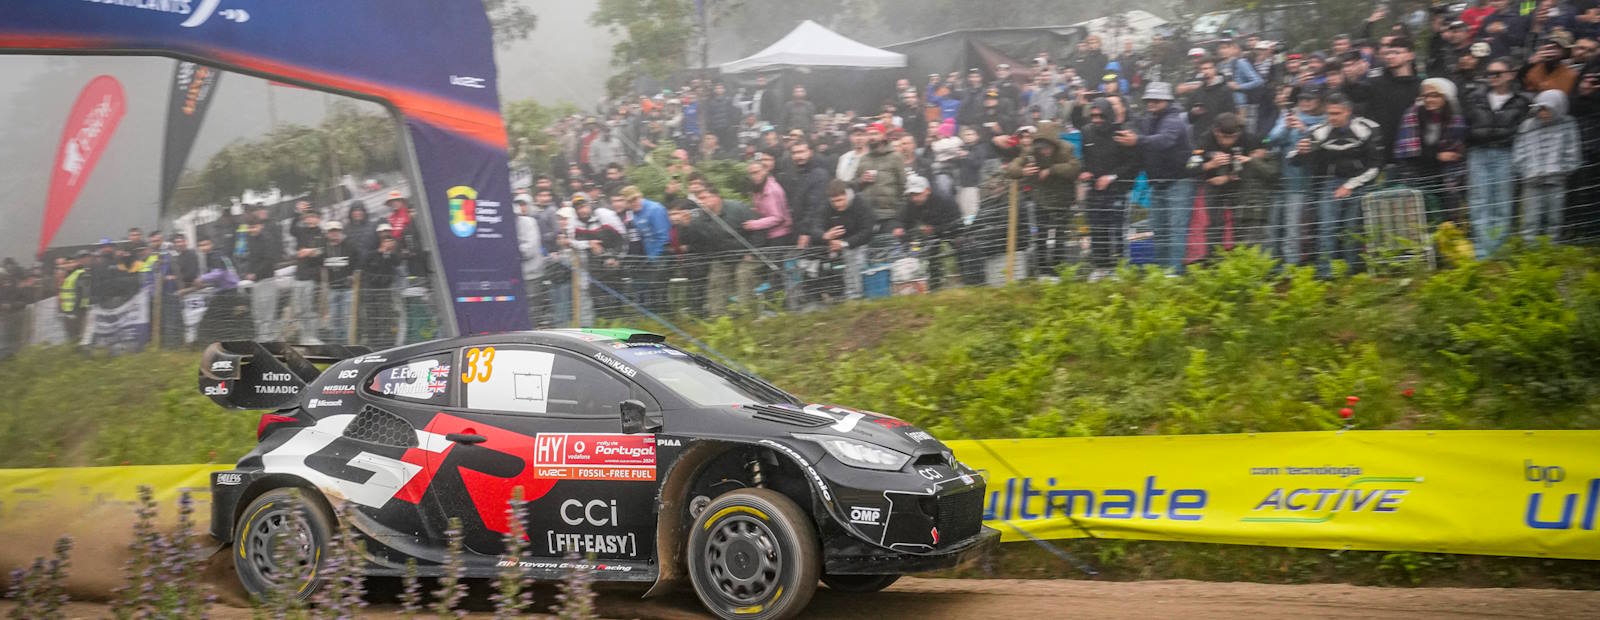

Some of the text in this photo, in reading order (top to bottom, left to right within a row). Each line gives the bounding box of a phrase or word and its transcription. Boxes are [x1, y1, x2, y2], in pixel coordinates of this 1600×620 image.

[462, 347, 496, 384] 33
[254, 385, 299, 394] TAMADIC
[538, 436, 563, 463] HY
[595, 445, 656, 458] Portugal
[567, 453, 591, 461] vodafone
[538, 468, 568, 477] WRC
[578, 469, 652, 479] FOSSIL-FREE FUEL
[1524, 459, 1567, 489] bp
[1252, 488, 1411, 512] ACTIVE
[850, 509, 881, 521] OMP
